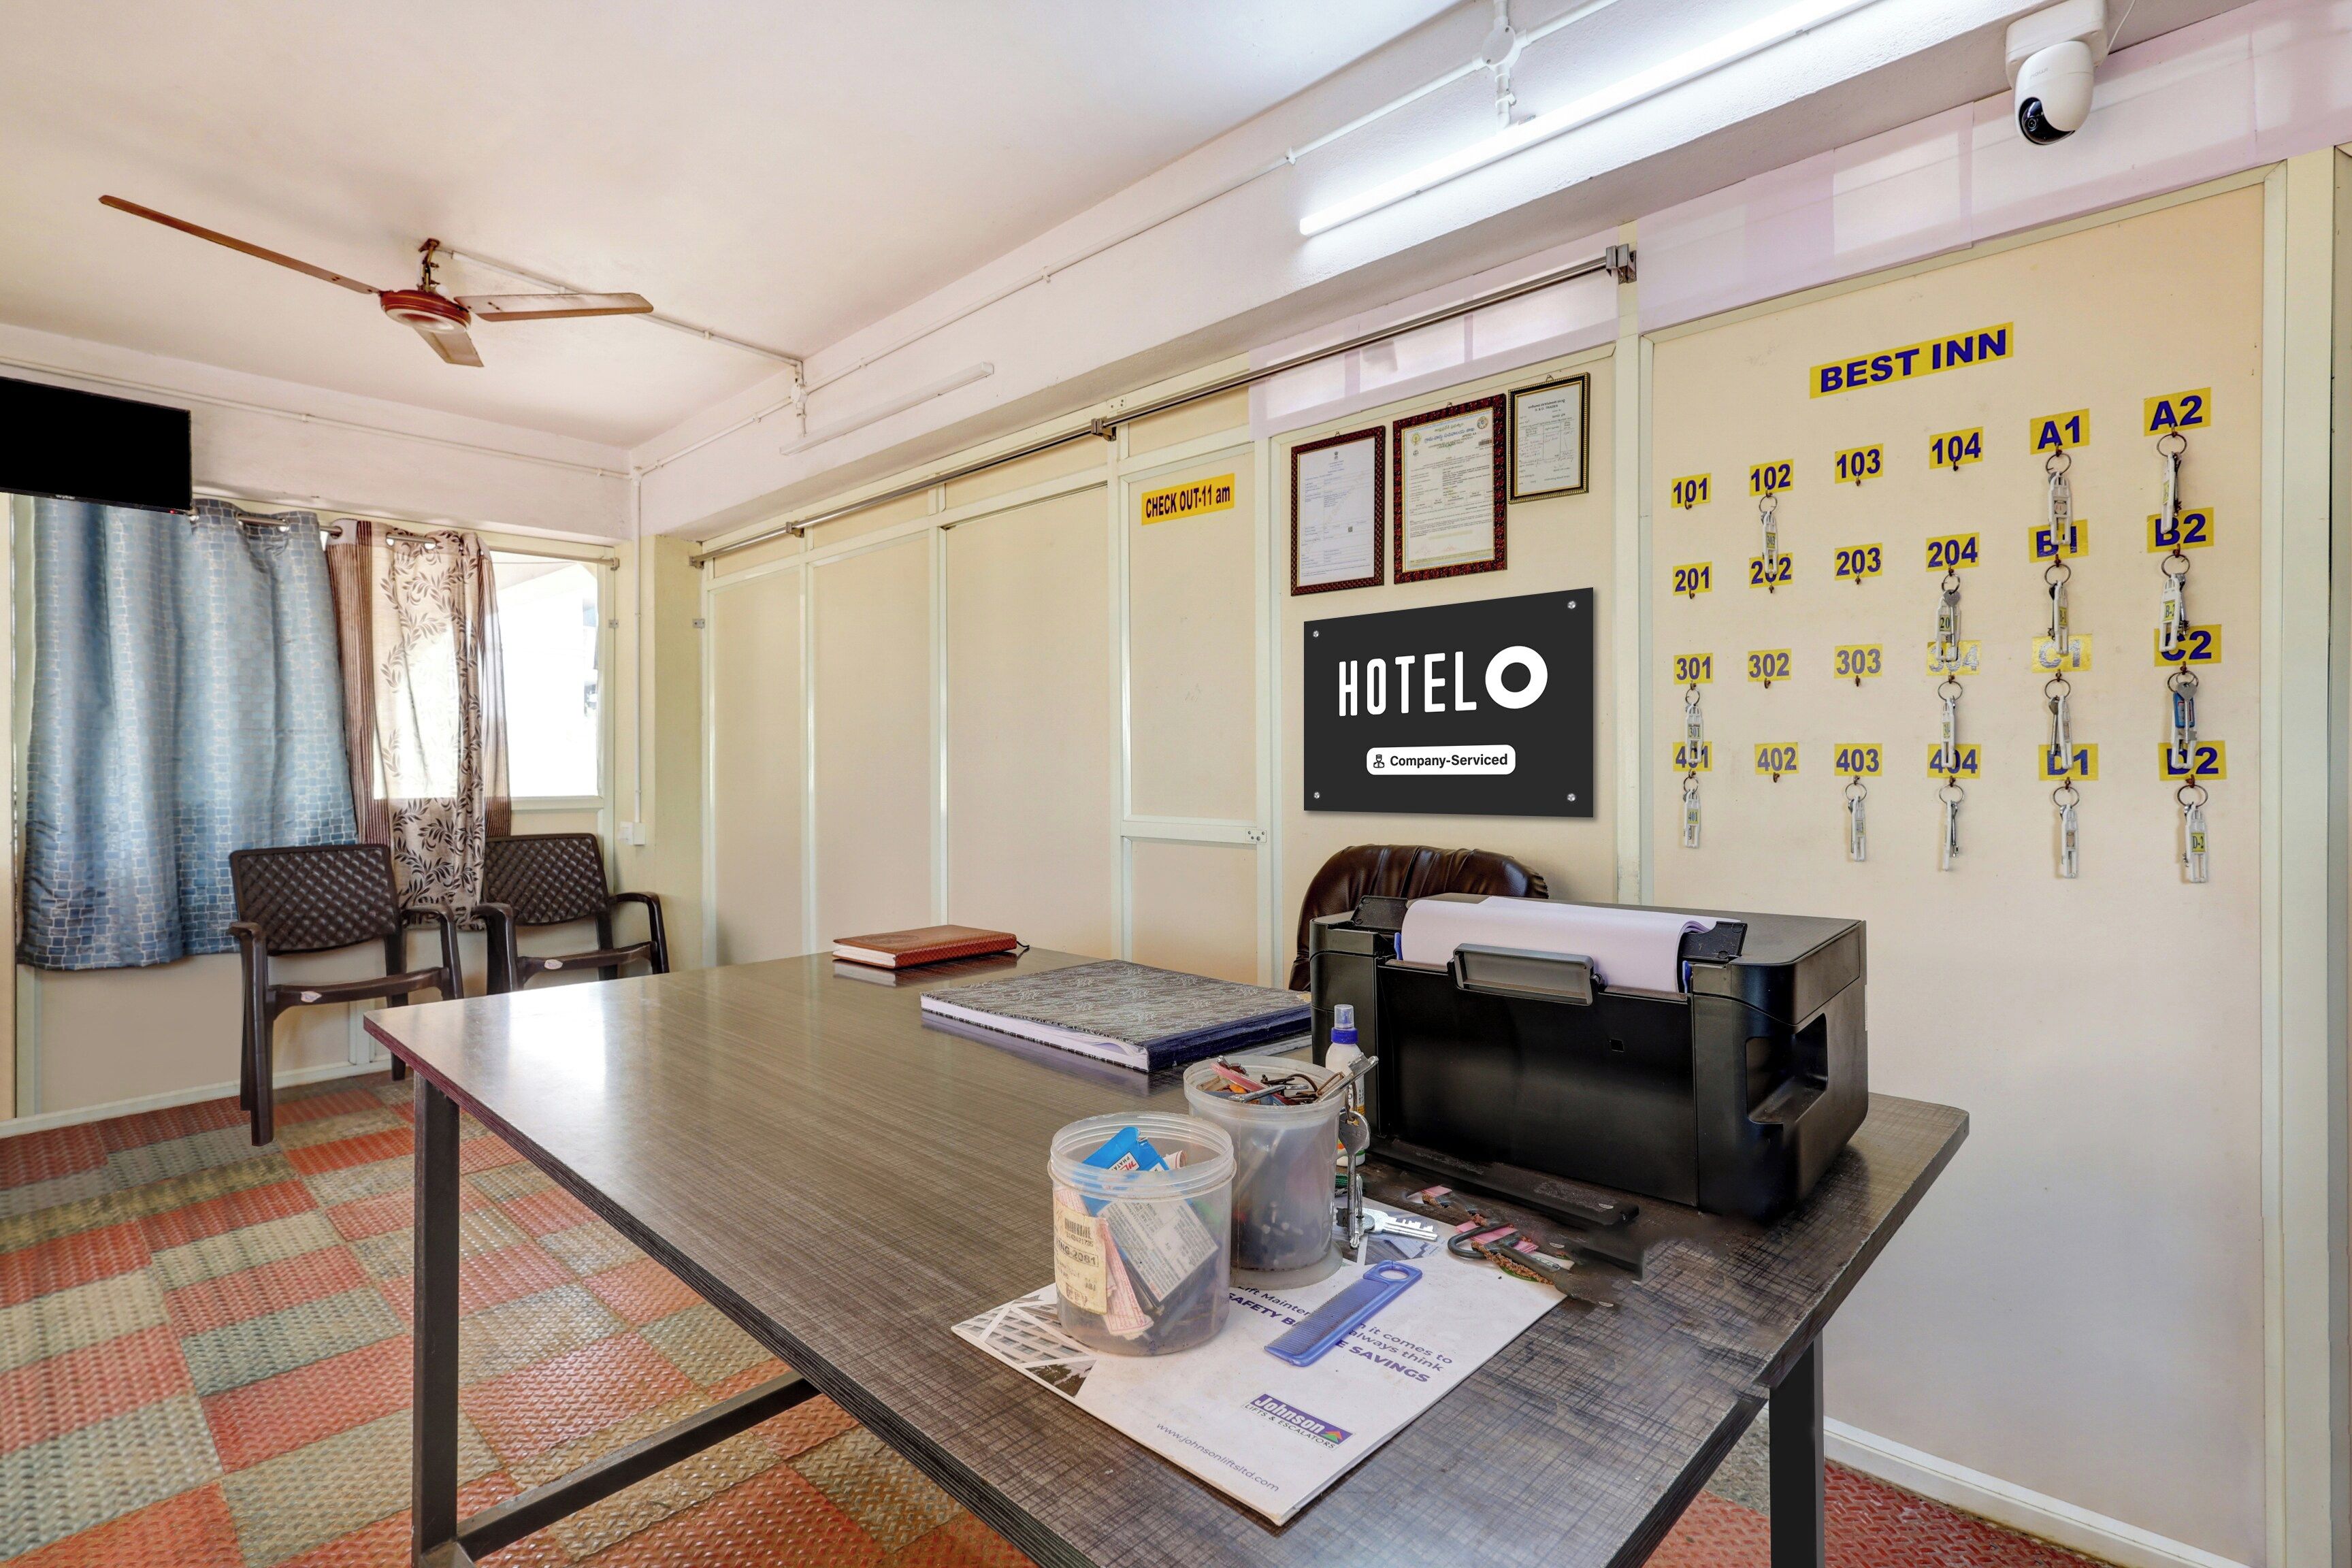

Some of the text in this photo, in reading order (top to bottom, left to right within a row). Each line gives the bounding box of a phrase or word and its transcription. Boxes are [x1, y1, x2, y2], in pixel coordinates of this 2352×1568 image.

[1820, 329, 2006, 393] BEST INN
[2149, 395, 2203, 431] A2
[1932, 431, 1981, 464] 104
[2037, 415, 2080, 450] A1
[1750, 463, 1791, 492] 102
[1836, 448, 1880, 478] 103
[1146, 484, 1230, 518] CHECK OUT-11 am
[1673, 478, 1708, 504] 101
[2036, 525, 2078, 558] B1
[2155, 513, 2206, 547] B2
[1836, 547, 1881, 576] 203
[1927, 536, 1978, 568] 204
[1674, 566, 1710, 592] 201
[1940, 617, 1950, 629] 20
[2038, 638, 2082, 669] C1
[2161, 630, 2212, 662] C2
[1676, 656, 1711, 681] 301
[1748, 652, 1790, 679] 302
[1836, 649, 1881, 675] 303
[1339, 651, 1477, 717] HOTEL
[1390, 753, 1508, 769] Company-Serviced
[1757, 747, 1797, 772] 402
[1836, 749, 1879, 772] 403
[1929, 749, 1978, 774] 404
[2047, 749, 2089, 776] D1
[2166, 746, 2219, 775] D2
[1229, 1292, 1431, 1382] SAFETY SAVINGS
[1349, 1329, 1399, 1353] always
[1401, 1351, 1443, 1372] think
[1369, 1326, 1453, 1364] it comes to
[1244, 1403, 1267, 1418] LIFTS
[1277, 1420, 1335, 1450] ESCALATORS
[1254, 1395, 1326, 1435] Johnson
[1157, 1422, 1279, 1492] www.johnsonliftsltd.com
